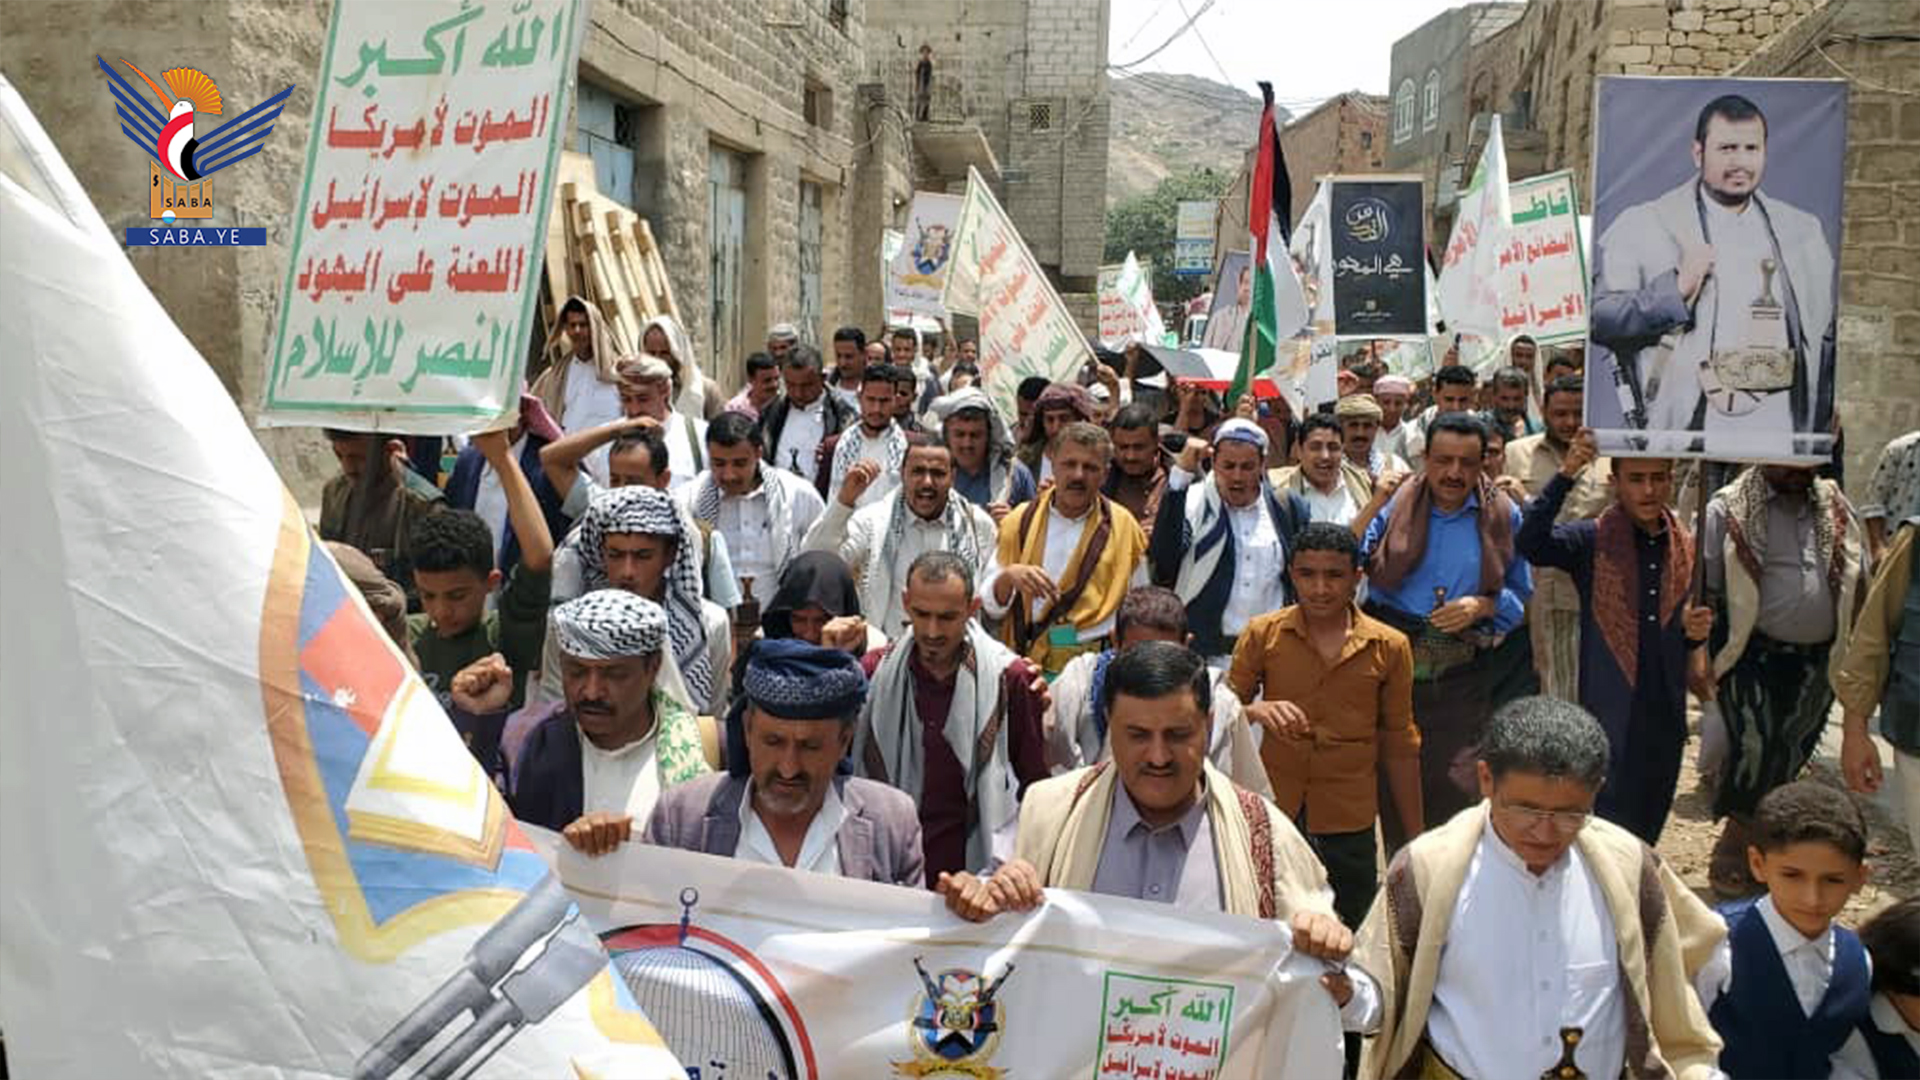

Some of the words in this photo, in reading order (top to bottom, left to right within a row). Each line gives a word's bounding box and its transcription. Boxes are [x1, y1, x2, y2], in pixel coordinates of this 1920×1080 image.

[334, 0, 485, 98] أكبر
[481, 0, 564, 68] الله
[328, 93, 449, 159] لأمريكا
[454, 91, 549, 154] الموت
[312, 173, 434, 231] لإسرائيل
[438, 169, 536, 228] الموت
[297, 249, 384, 303] اليهود
[387, 249, 434, 304] على
[447, 244, 525, 293] اللعنة
[281, 315, 404, 397] للإسلام
[398, 311, 513, 394] النصر
[1110, 985, 1180, 1022] أكبر
[1181, 991, 1226, 1022] الله
[1107, 1022, 1167, 1046] لأمريكا
[1170, 1033, 1219, 1057] الموت
